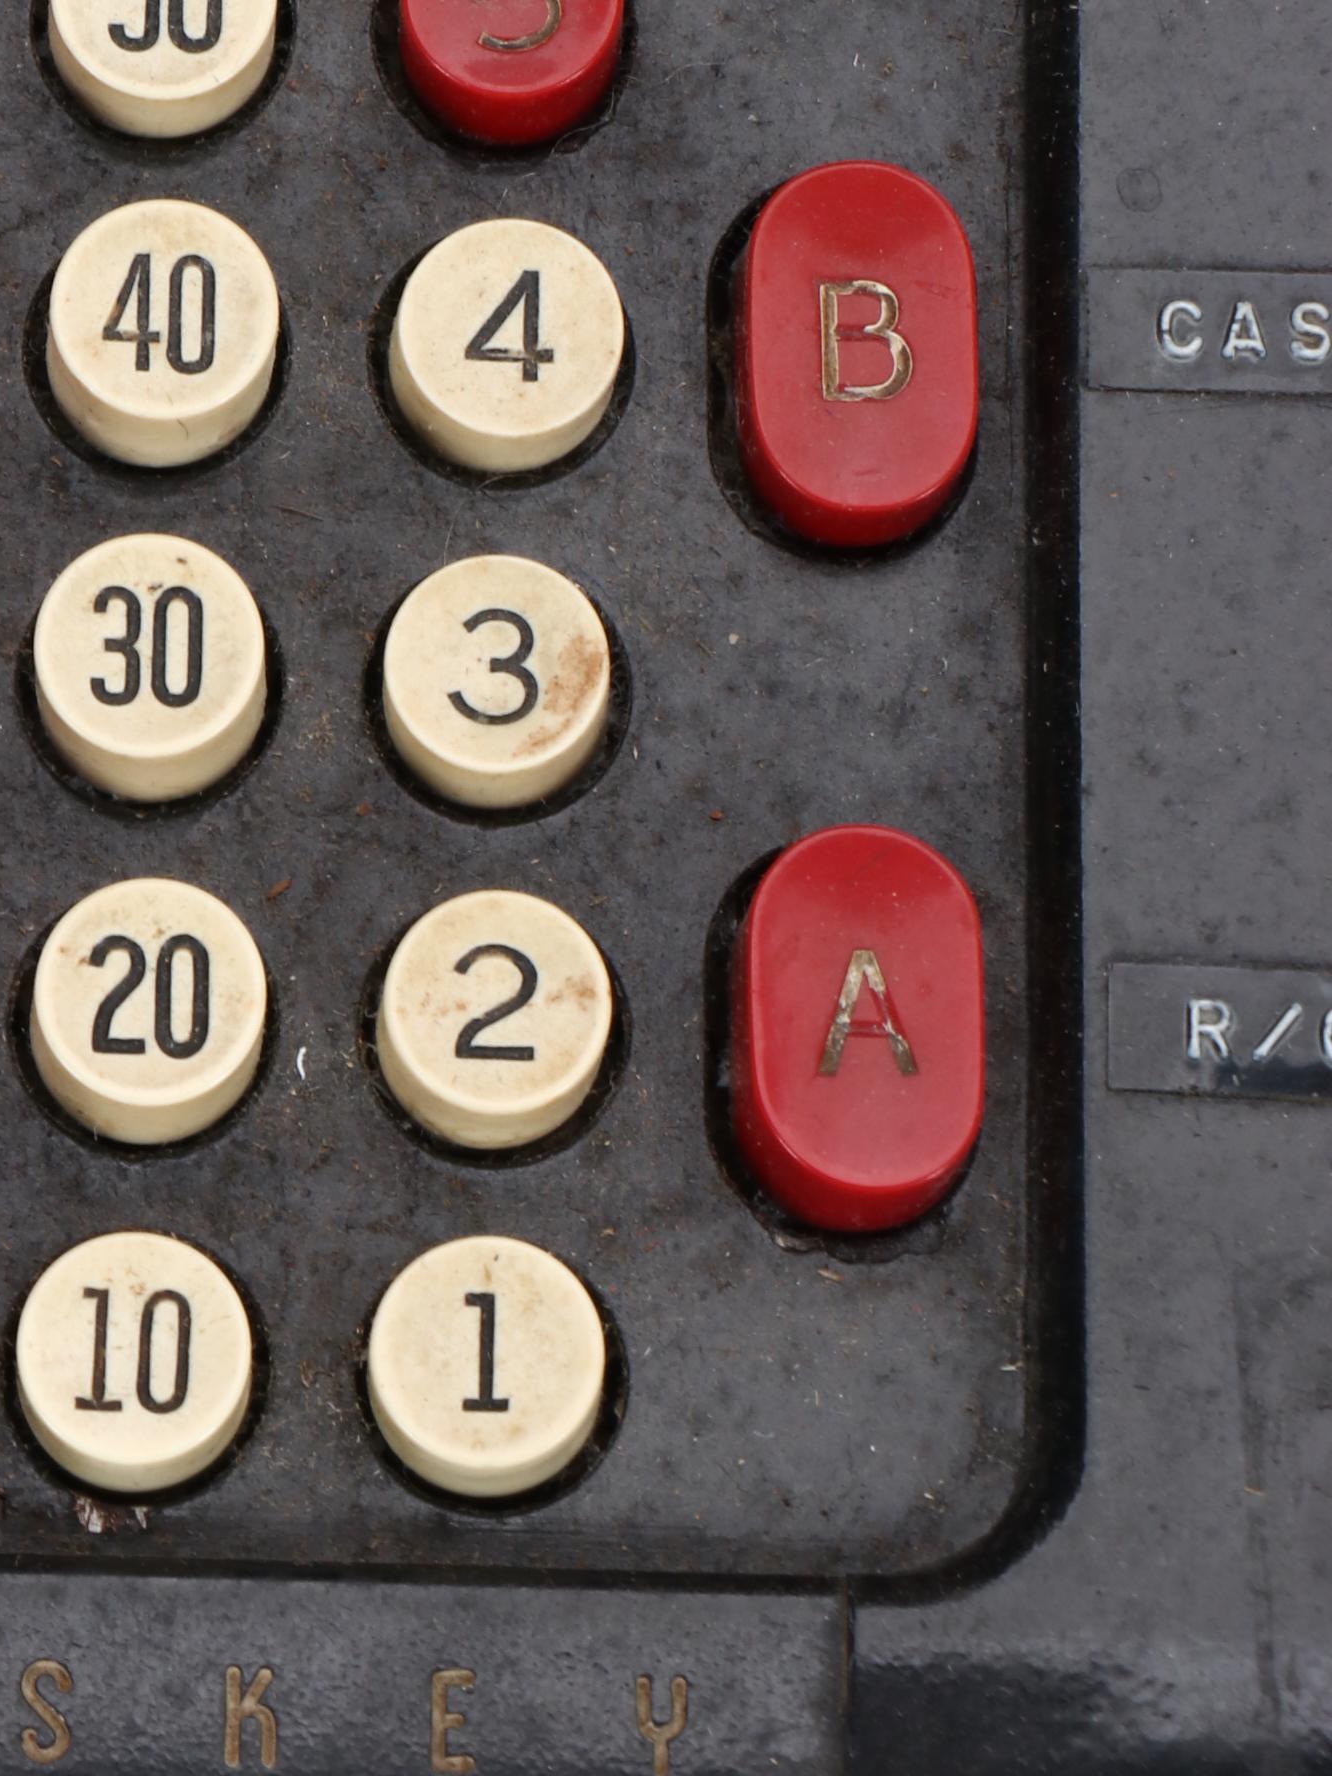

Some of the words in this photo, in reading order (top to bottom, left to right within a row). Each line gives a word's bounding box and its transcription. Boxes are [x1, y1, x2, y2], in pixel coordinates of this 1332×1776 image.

[102, 253, 216, 375] 40
[464, 270, 554, 382] 4
[819, 280, 913, 402] B
[1159, 299, 1332, 363] CAS
[89, 585, 204, 708] 30
[447, 608, 539, 725] 3
[88, 934, 210, 1059] 20
[453, 944, 537, 1061] 2
[815, 949, 919, 1077] A
[1185, 998, 1332, 1063] R/
[75, 1287, 191, 1414] 10
[461, 1292, 509, 1412] 1
